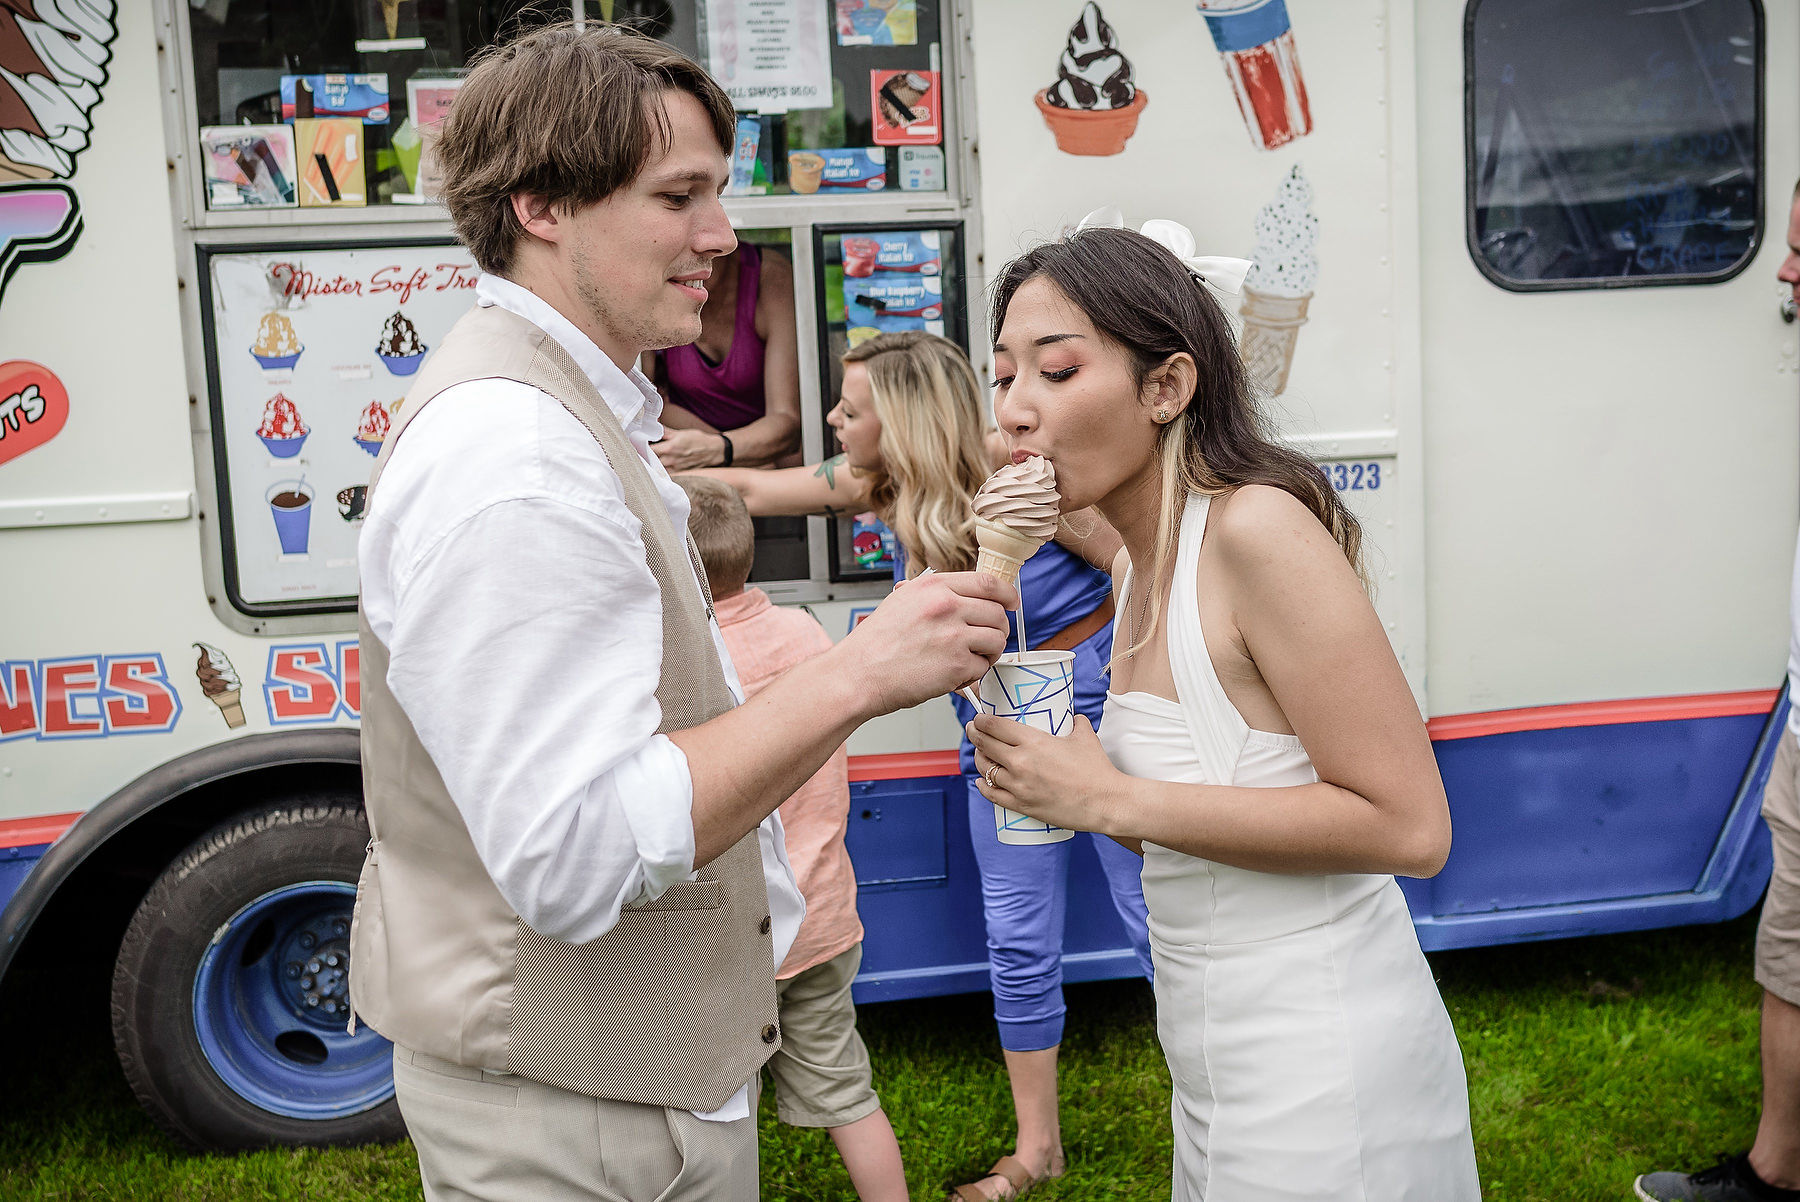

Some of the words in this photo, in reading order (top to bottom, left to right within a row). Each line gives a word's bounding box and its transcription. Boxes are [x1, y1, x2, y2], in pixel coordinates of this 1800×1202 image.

[273, 263, 363, 300] Mister
[370, 265, 432, 304] Soft
[0, 384, 46, 440] TS
